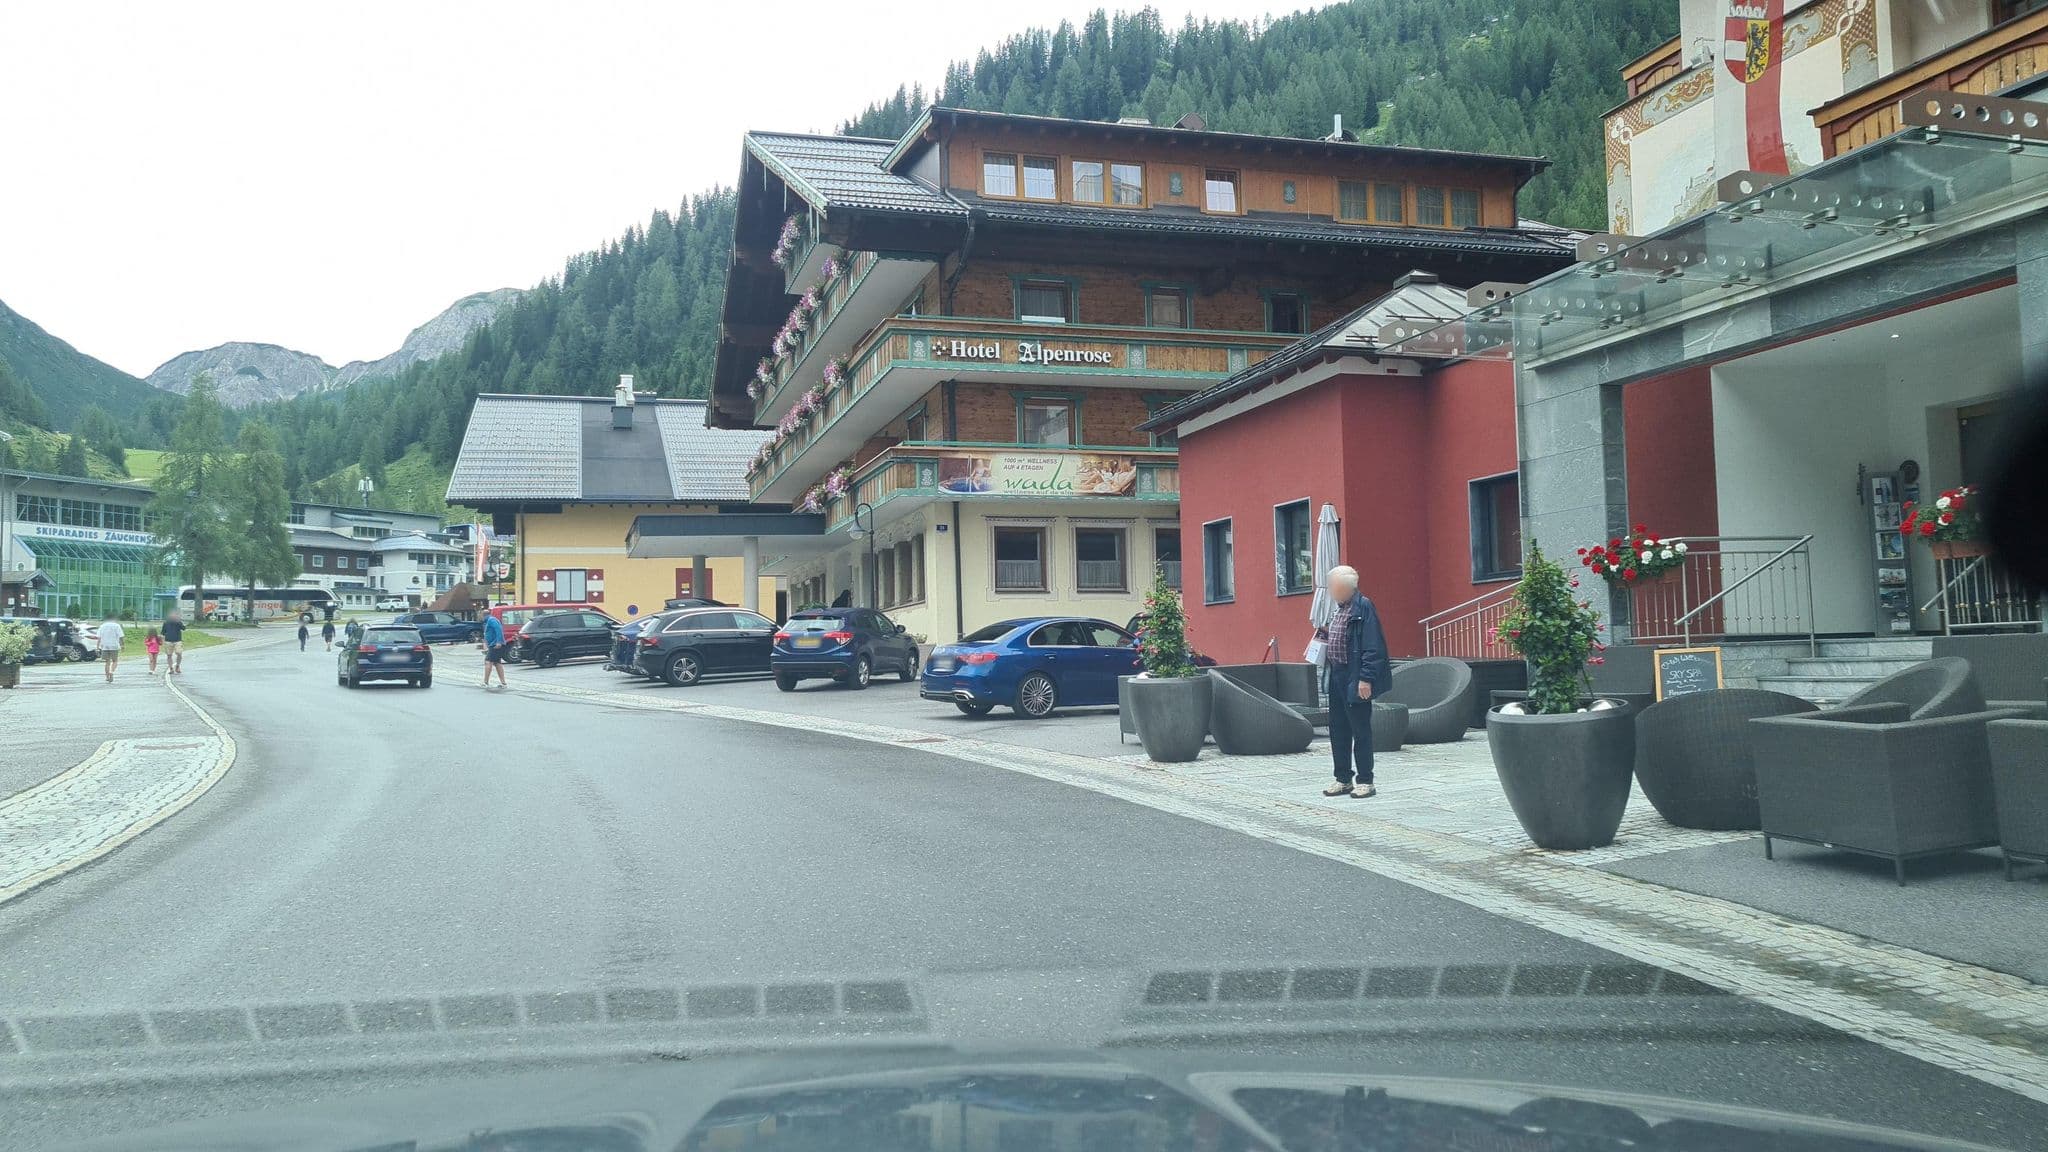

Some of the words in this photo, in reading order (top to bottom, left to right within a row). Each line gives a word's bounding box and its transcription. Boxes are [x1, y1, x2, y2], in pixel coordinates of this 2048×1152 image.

[950, 340, 1000, 359] Hotel
[1018, 342, 1112, 364] Alpenrose
[1003, 454, 1073, 490] wada
[36, 527, 99, 539] SKIPARADIES
